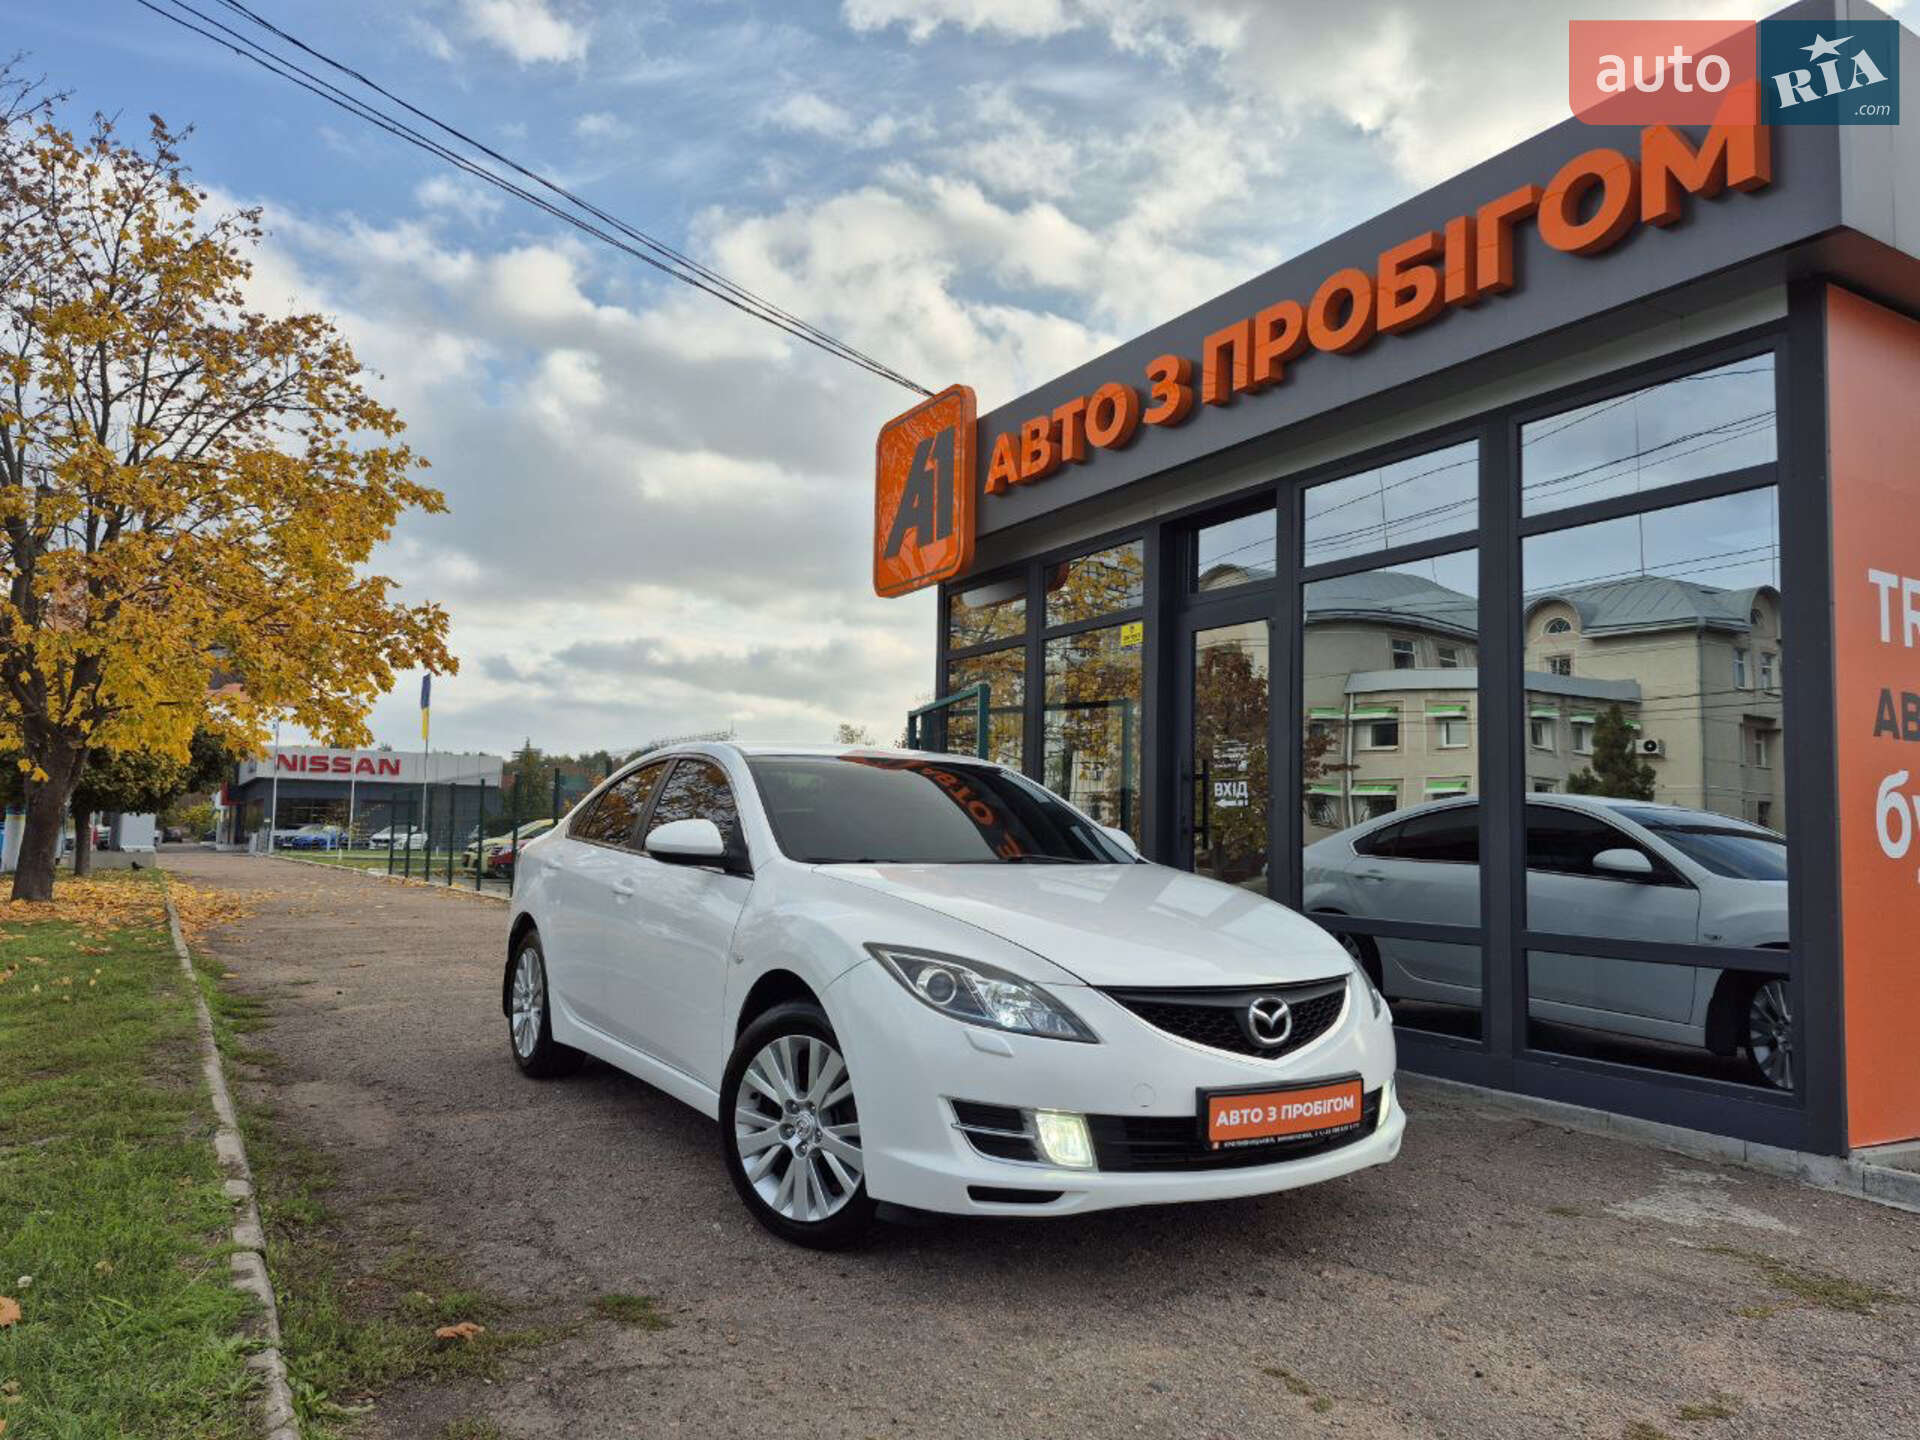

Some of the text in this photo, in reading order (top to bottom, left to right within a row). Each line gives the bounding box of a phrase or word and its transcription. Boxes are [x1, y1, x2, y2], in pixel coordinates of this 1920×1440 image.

[984, 78, 1768, 494] АВТО З ПРОБІГОМ
[277, 754, 401, 776] NISSAN
[1214, 781, 1248, 799] ВХІД
[1216, 1094, 1355, 1127] АВТО З ПРОБІГОМ
